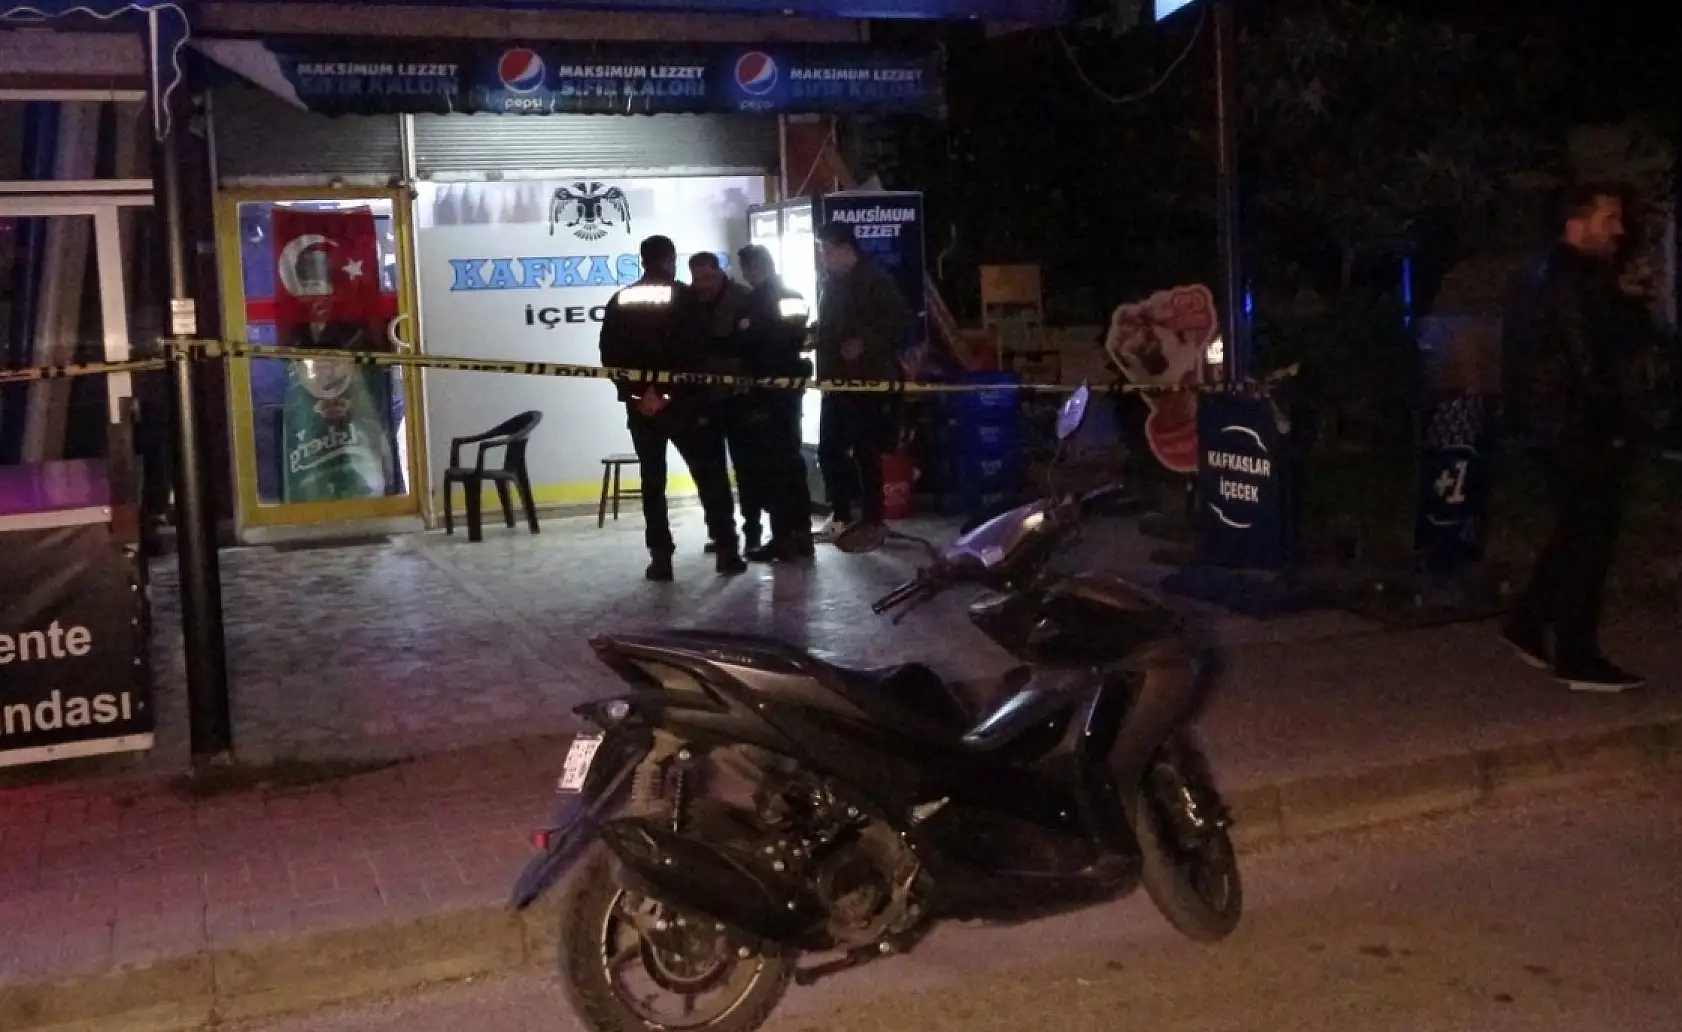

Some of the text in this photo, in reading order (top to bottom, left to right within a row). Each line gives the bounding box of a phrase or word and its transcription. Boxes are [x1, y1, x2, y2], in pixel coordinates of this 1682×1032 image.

[398, 62, 458, 76] LEZZET
[651, 65, 705, 78] LEZZET
[873, 68, 923, 81] LEZZET
[504, 97, 543, 109] pepsi
[832, 205, 916, 222] MAKSİMUM
[853, 223, 902, 240] EZZET
[450, 253, 641, 291] KAFKAS
[525, 303, 607, 330] İÇEC
[1207, 450, 1271, 478] KAFKASLAR
[1219, 476, 1259, 503] İÇECEK
[1432, 459, 1469, 505] +1
